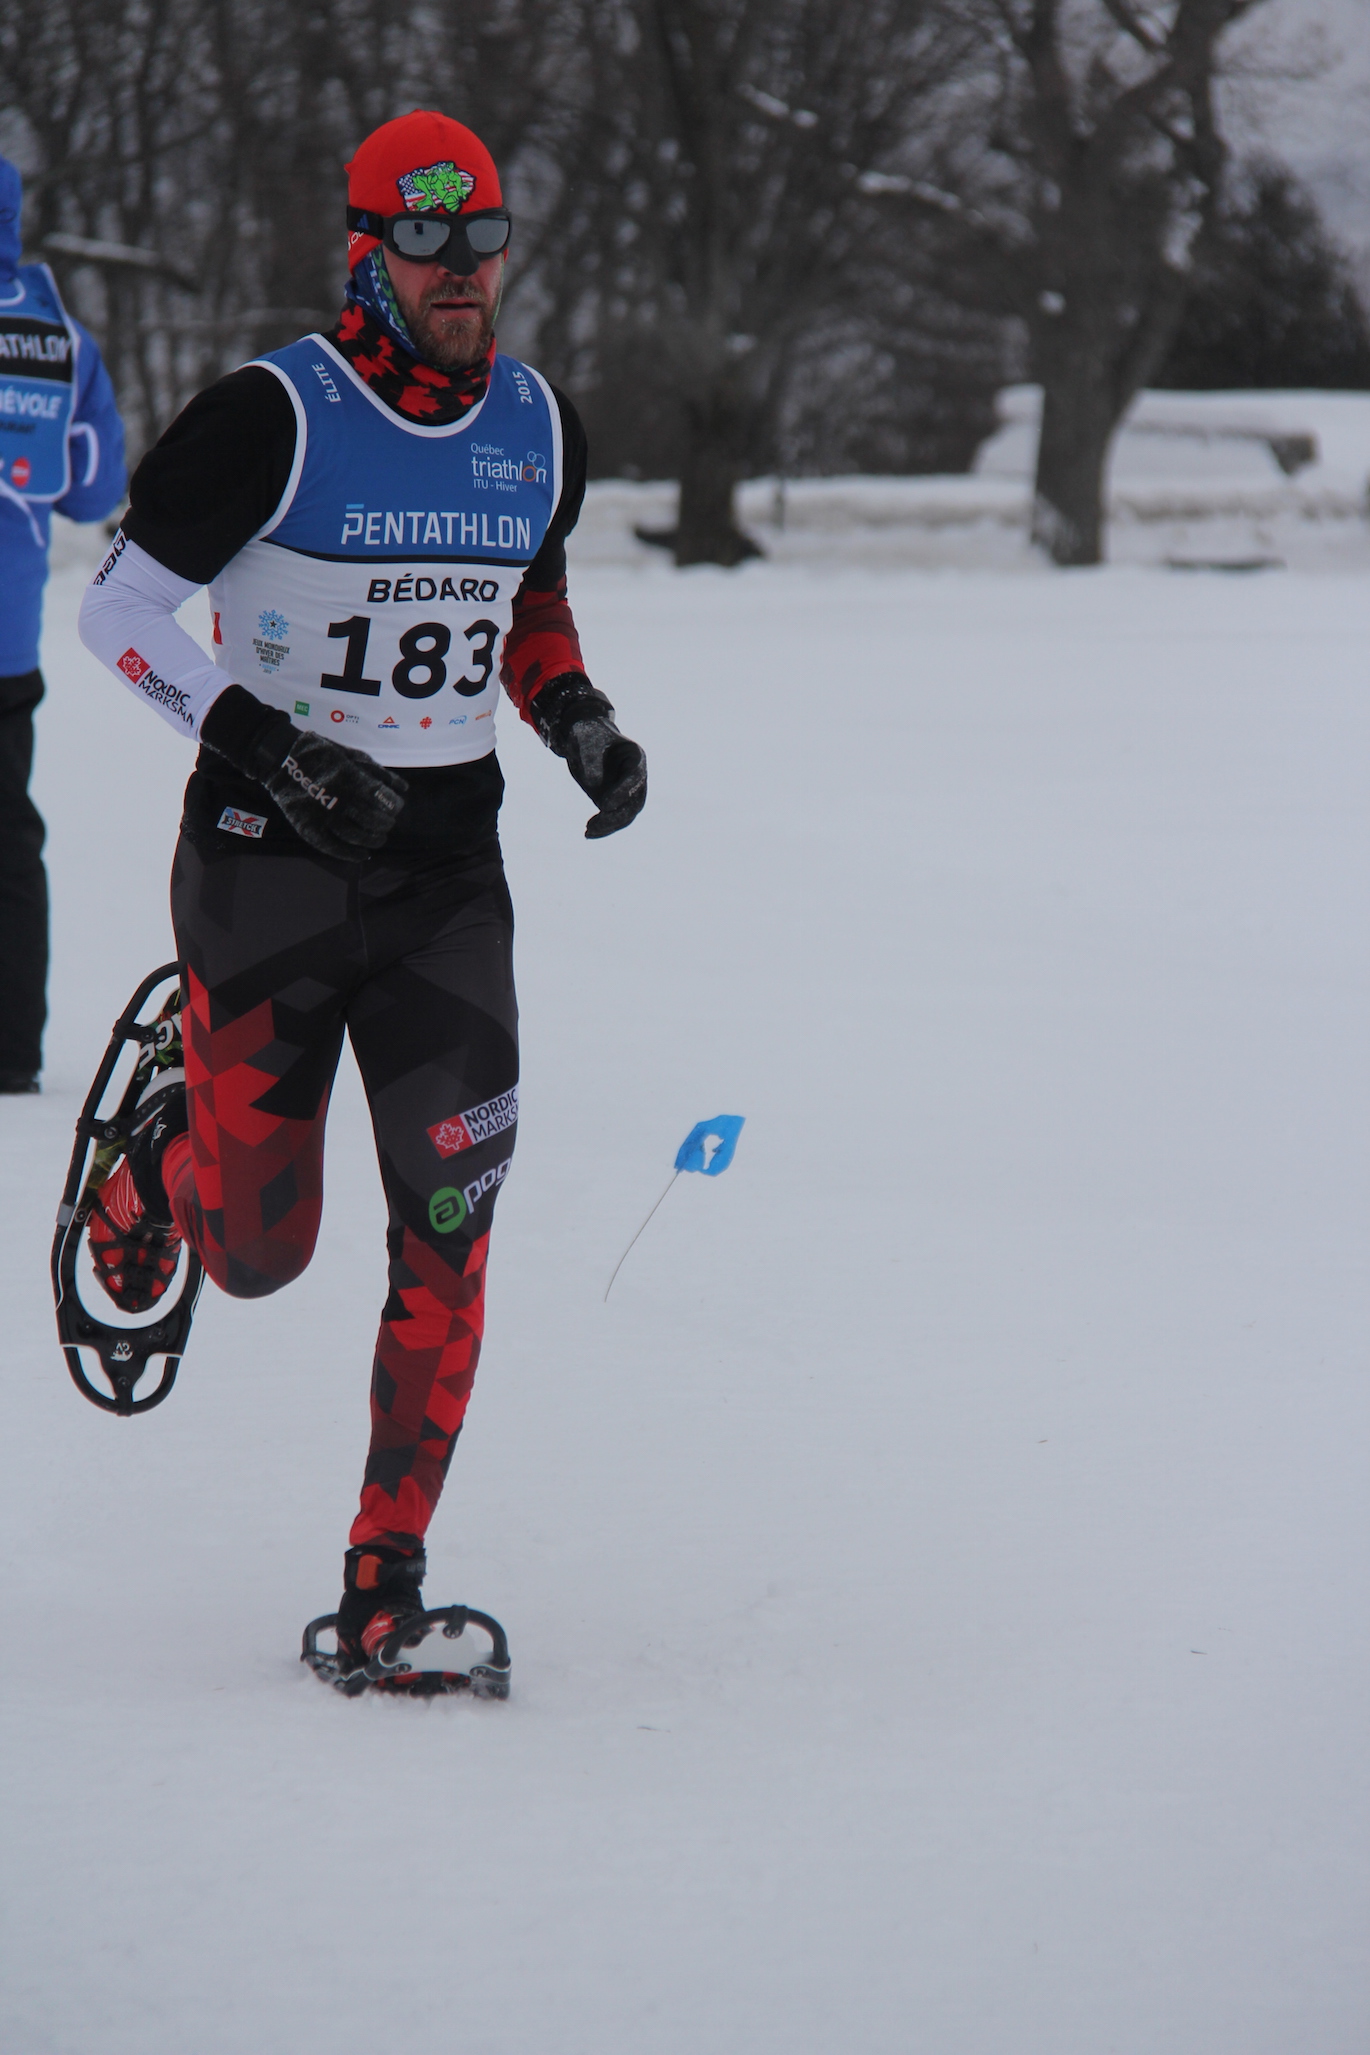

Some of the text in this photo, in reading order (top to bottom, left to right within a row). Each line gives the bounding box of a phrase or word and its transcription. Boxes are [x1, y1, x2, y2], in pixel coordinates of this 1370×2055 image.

[312, 363, 342, 403] ÉLITE
[513, 371, 533, 404] 2015
[471, 443, 505, 456] Québec
[471, 457, 547, 484] triathlon
[473, 479, 489, 490] ITU
[496, 481, 518, 493] Hiver
[341, 510, 531, 550] PENTATHLON
[367, 573, 499, 602] BÉDARD
[320, 615, 500, 699] 183
[464, 1088, 518, 1128] NORDIC
[471, 1104, 519, 1142] MARKS
